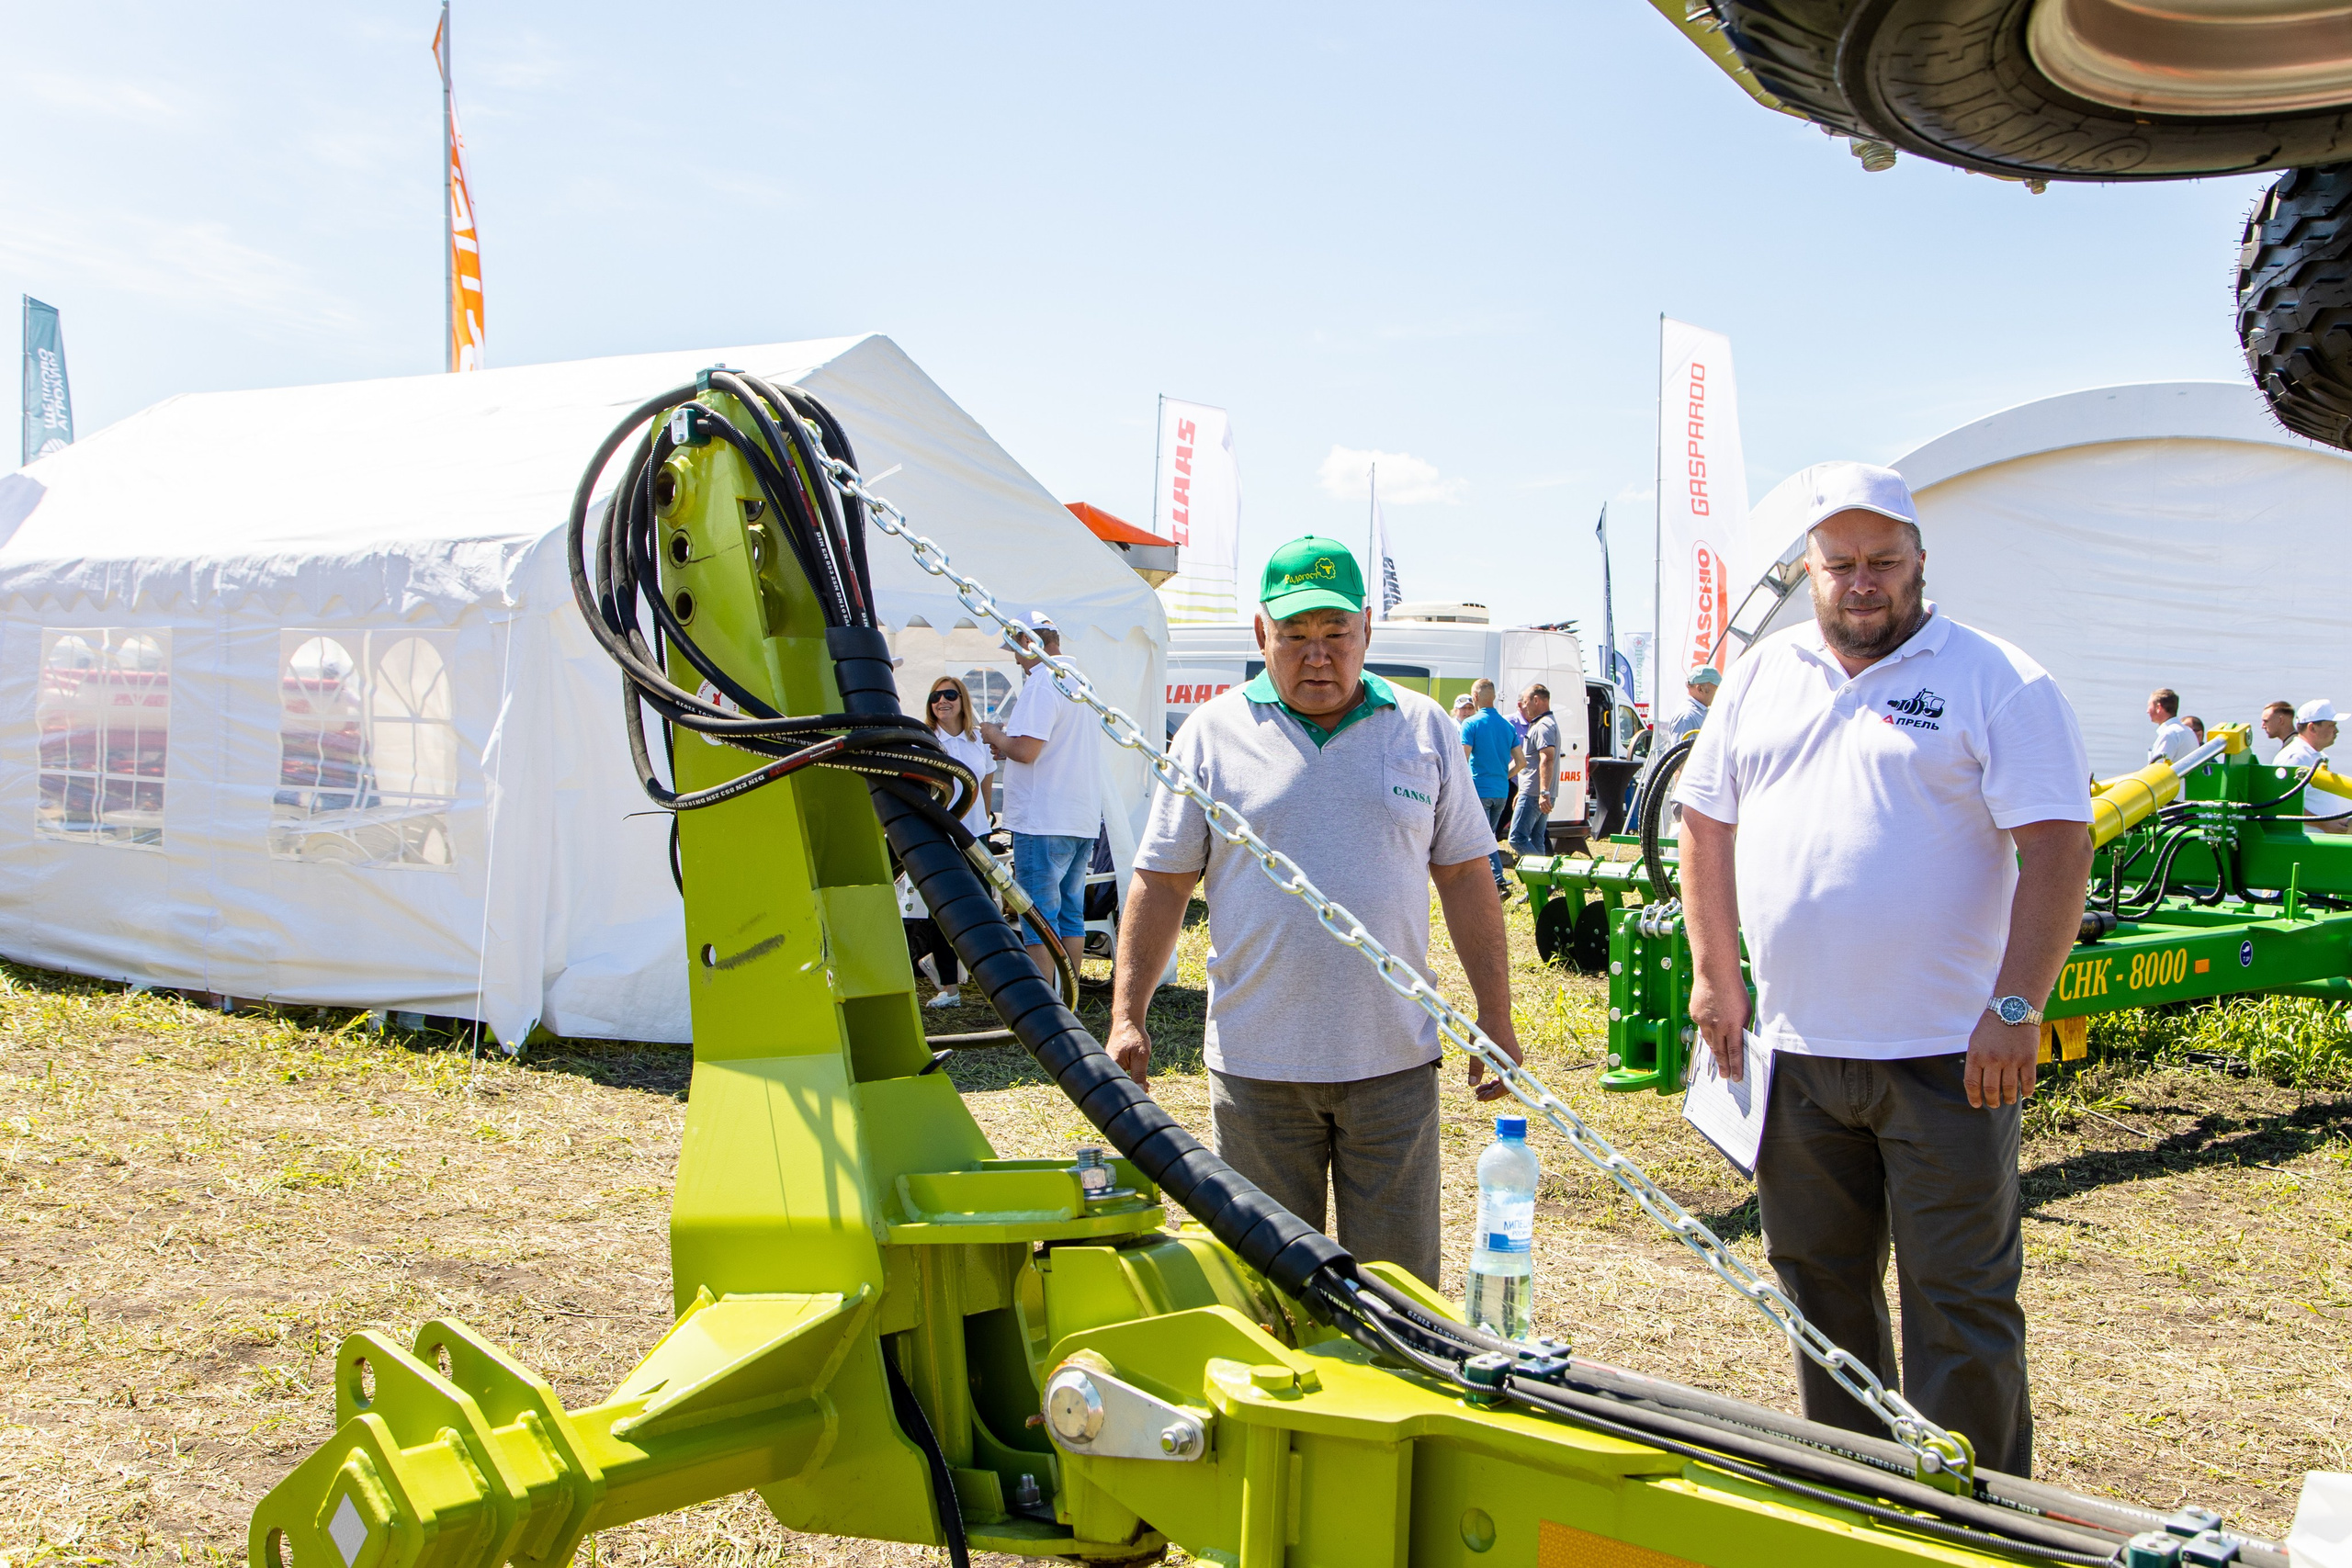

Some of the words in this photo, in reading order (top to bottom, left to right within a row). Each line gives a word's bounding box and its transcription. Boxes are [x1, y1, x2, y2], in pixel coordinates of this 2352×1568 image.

[1688, 362, 1710, 516] GASPARDO
[1172, 417, 1195, 547] CLAAS
[816, 531, 825, 547] DIN
[821, 547, 829, 559] EN
[826, 560, 834, 575] 853
[1691, 548, 1712, 668] MASCHIO
[1166, 684, 1230, 704] LAA
[736, 782, 748, 791] EN
[749, 774, 765, 785] DIN
[1560, 772, 1581, 781] LAAS
[720, 786, 735, 796] 853
[1393, 785, 1431, 806] CANSA
[2130, 948, 2188, 990] 8000
